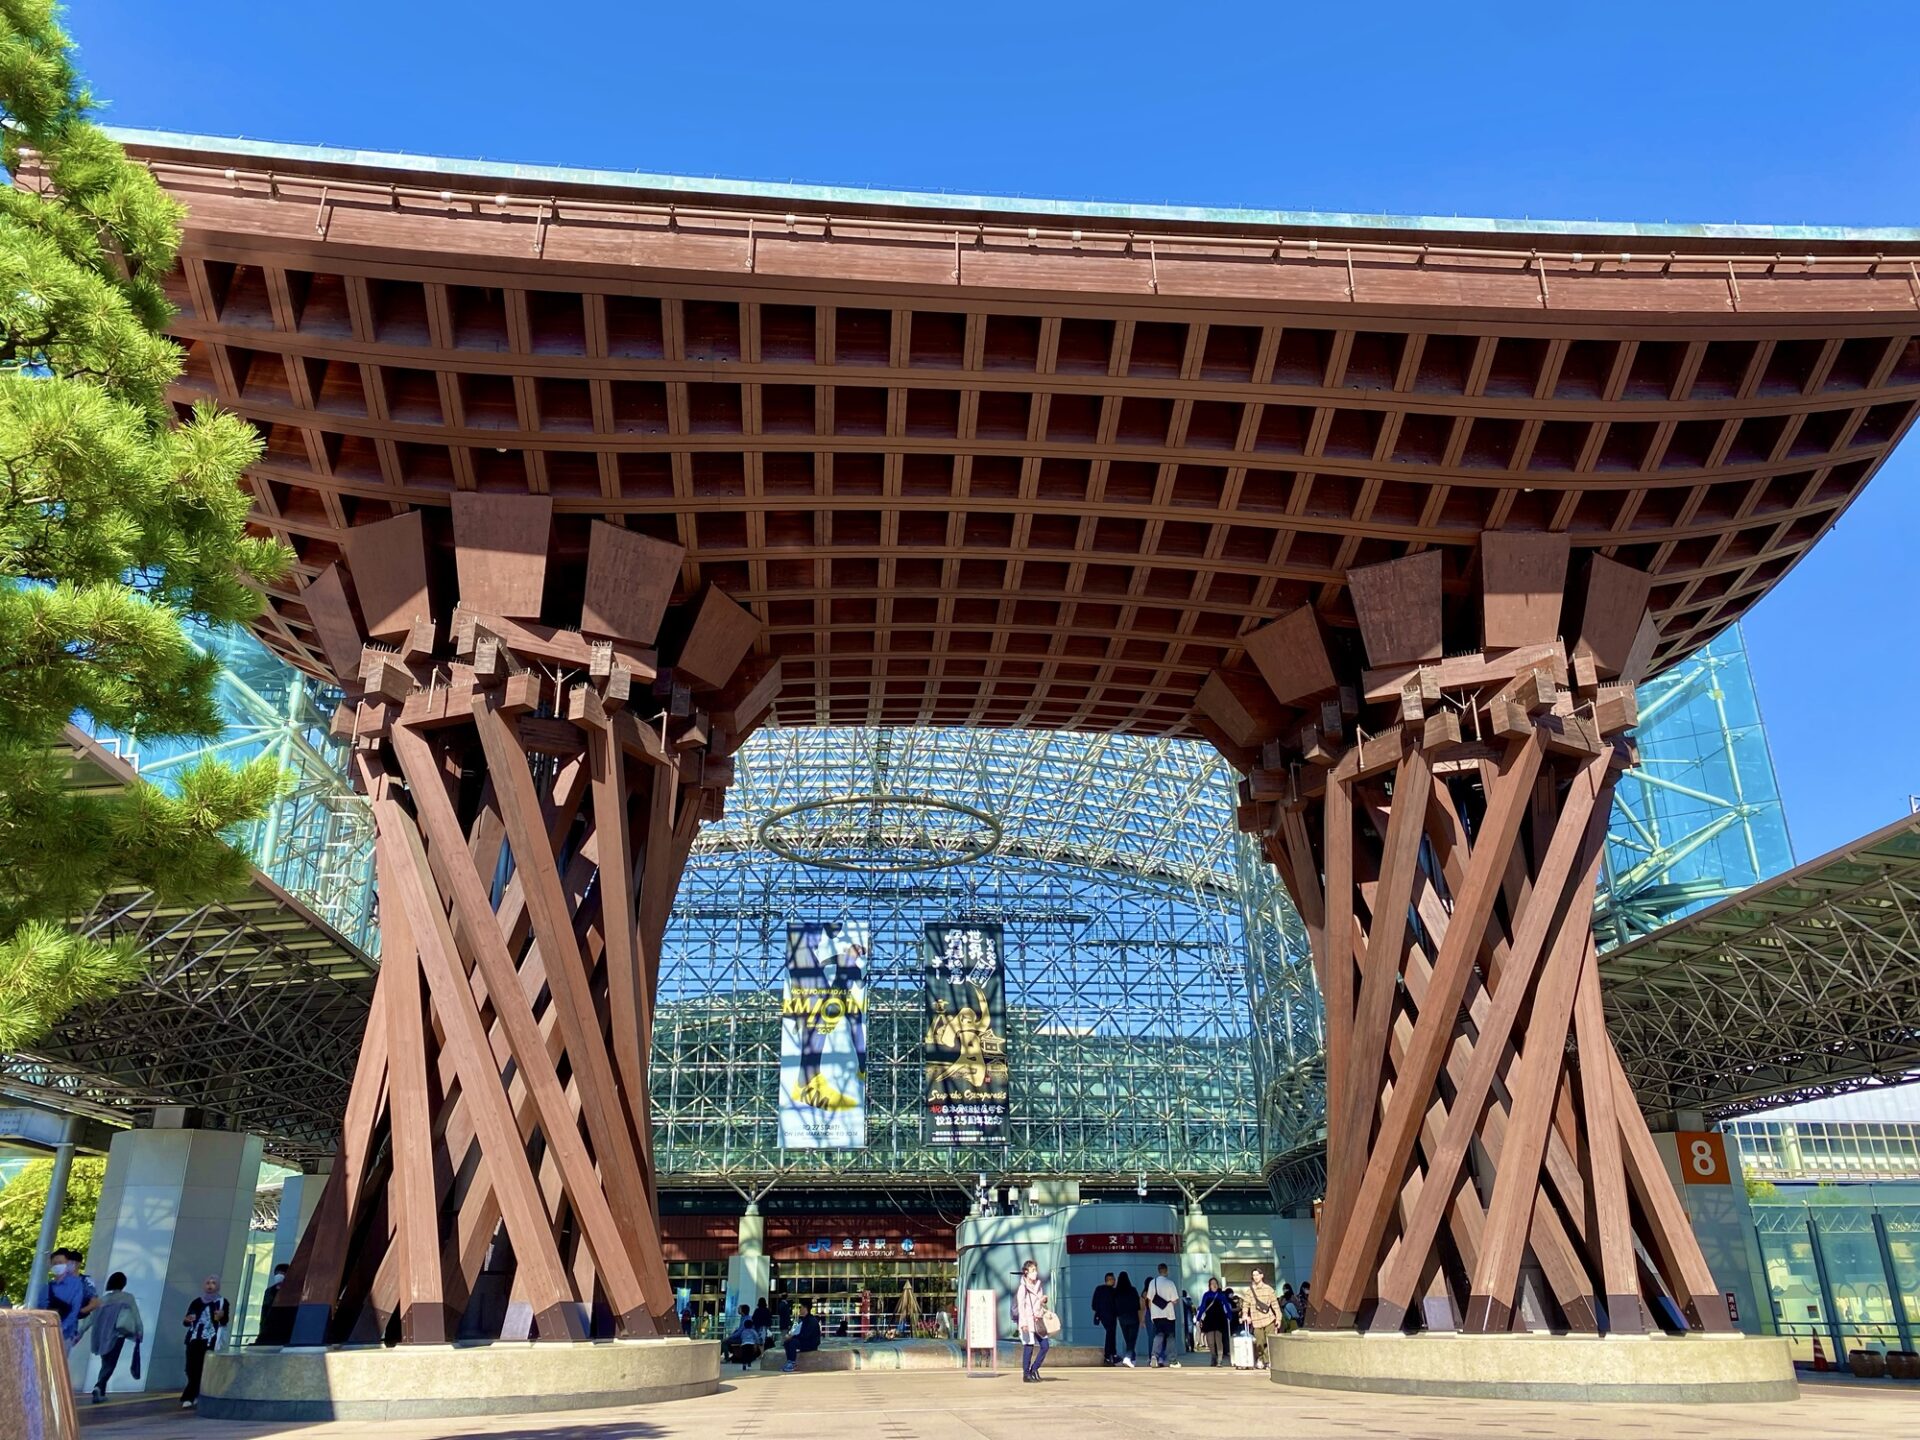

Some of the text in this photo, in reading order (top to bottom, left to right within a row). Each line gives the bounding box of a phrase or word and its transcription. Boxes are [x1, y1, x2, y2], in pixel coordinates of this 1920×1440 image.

[966, 929, 983, 960] 世界
[1691, 1140, 1716, 1176] 8
[807, 1238, 832, 1254] JR
[842, 1238, 887, 1250] 金沢駅
